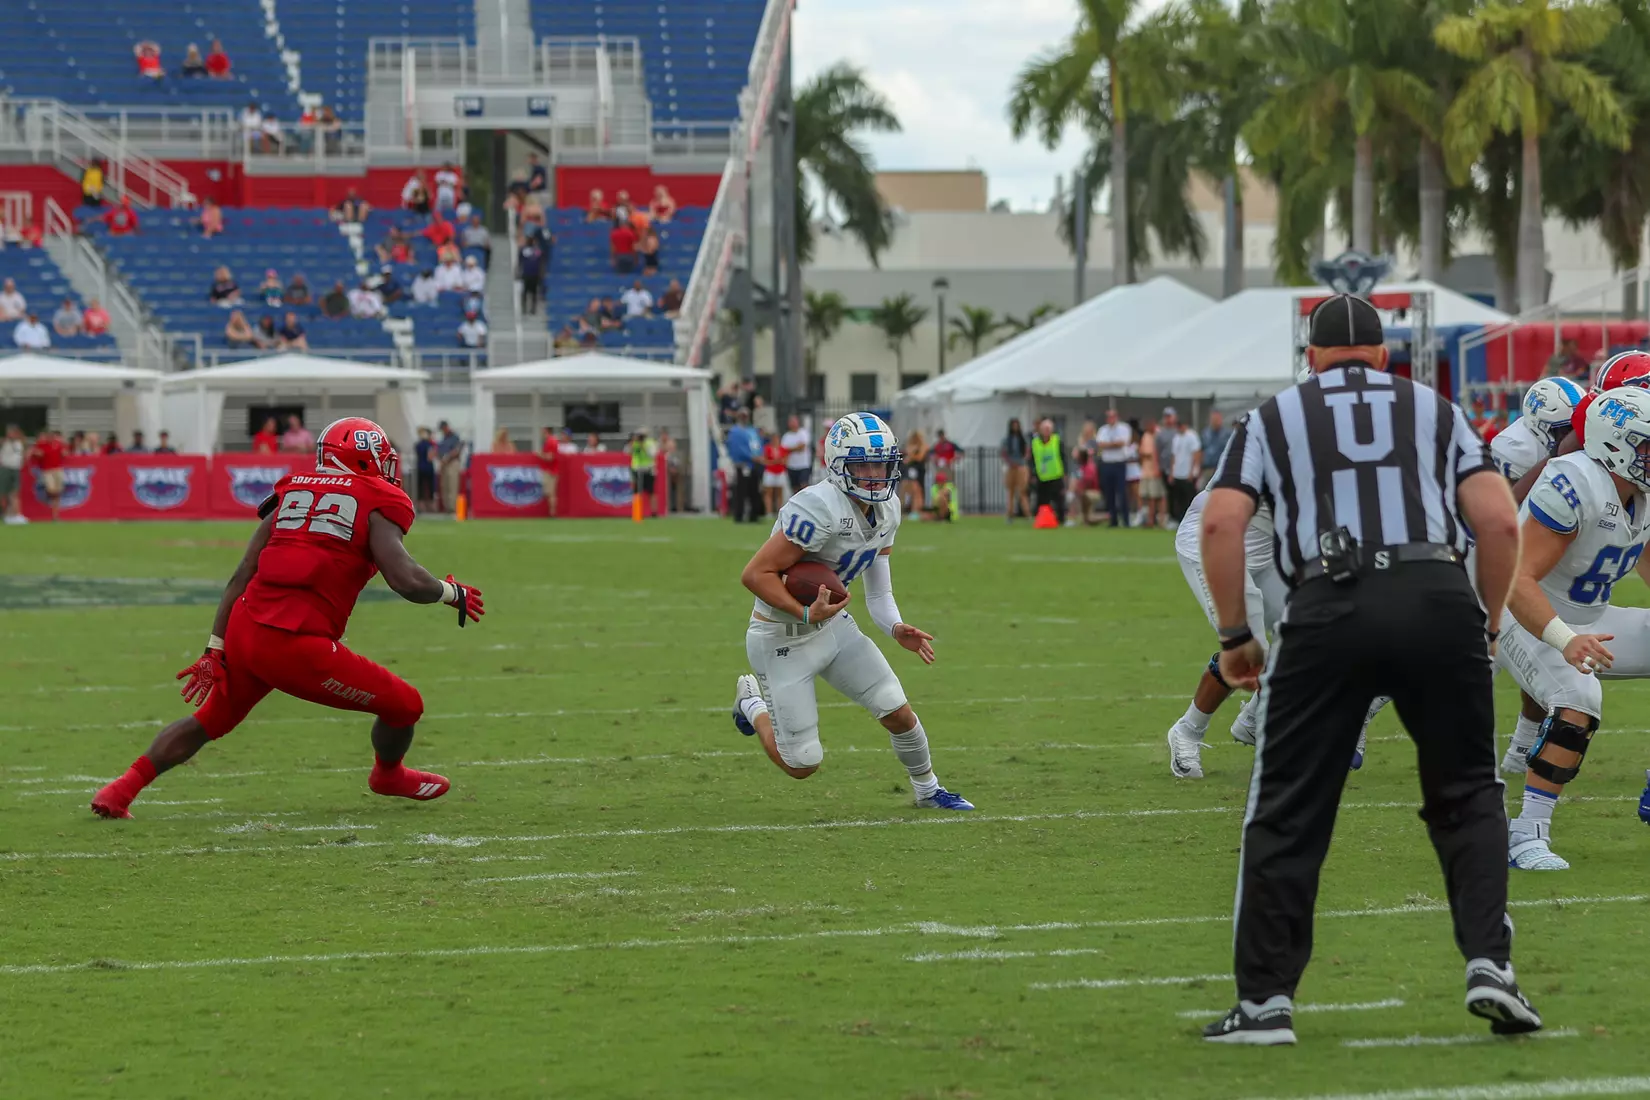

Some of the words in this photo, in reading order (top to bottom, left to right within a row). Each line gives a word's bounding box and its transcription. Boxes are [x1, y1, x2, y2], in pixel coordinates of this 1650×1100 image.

[1324, 391, 1396, 463] U
[1599, 397, 1636, 429] MT
[353, 430, 382, 451] 92
[291, 476, 353, 487] SOUTHALL
[275, 490, 357, 542] 92
[785, 513, 815, 545] 10
[833, 547, 878, 588] 10
[1374, 551, 1390, 570] S
[321, 677, 376, 706] ATLANTIC
